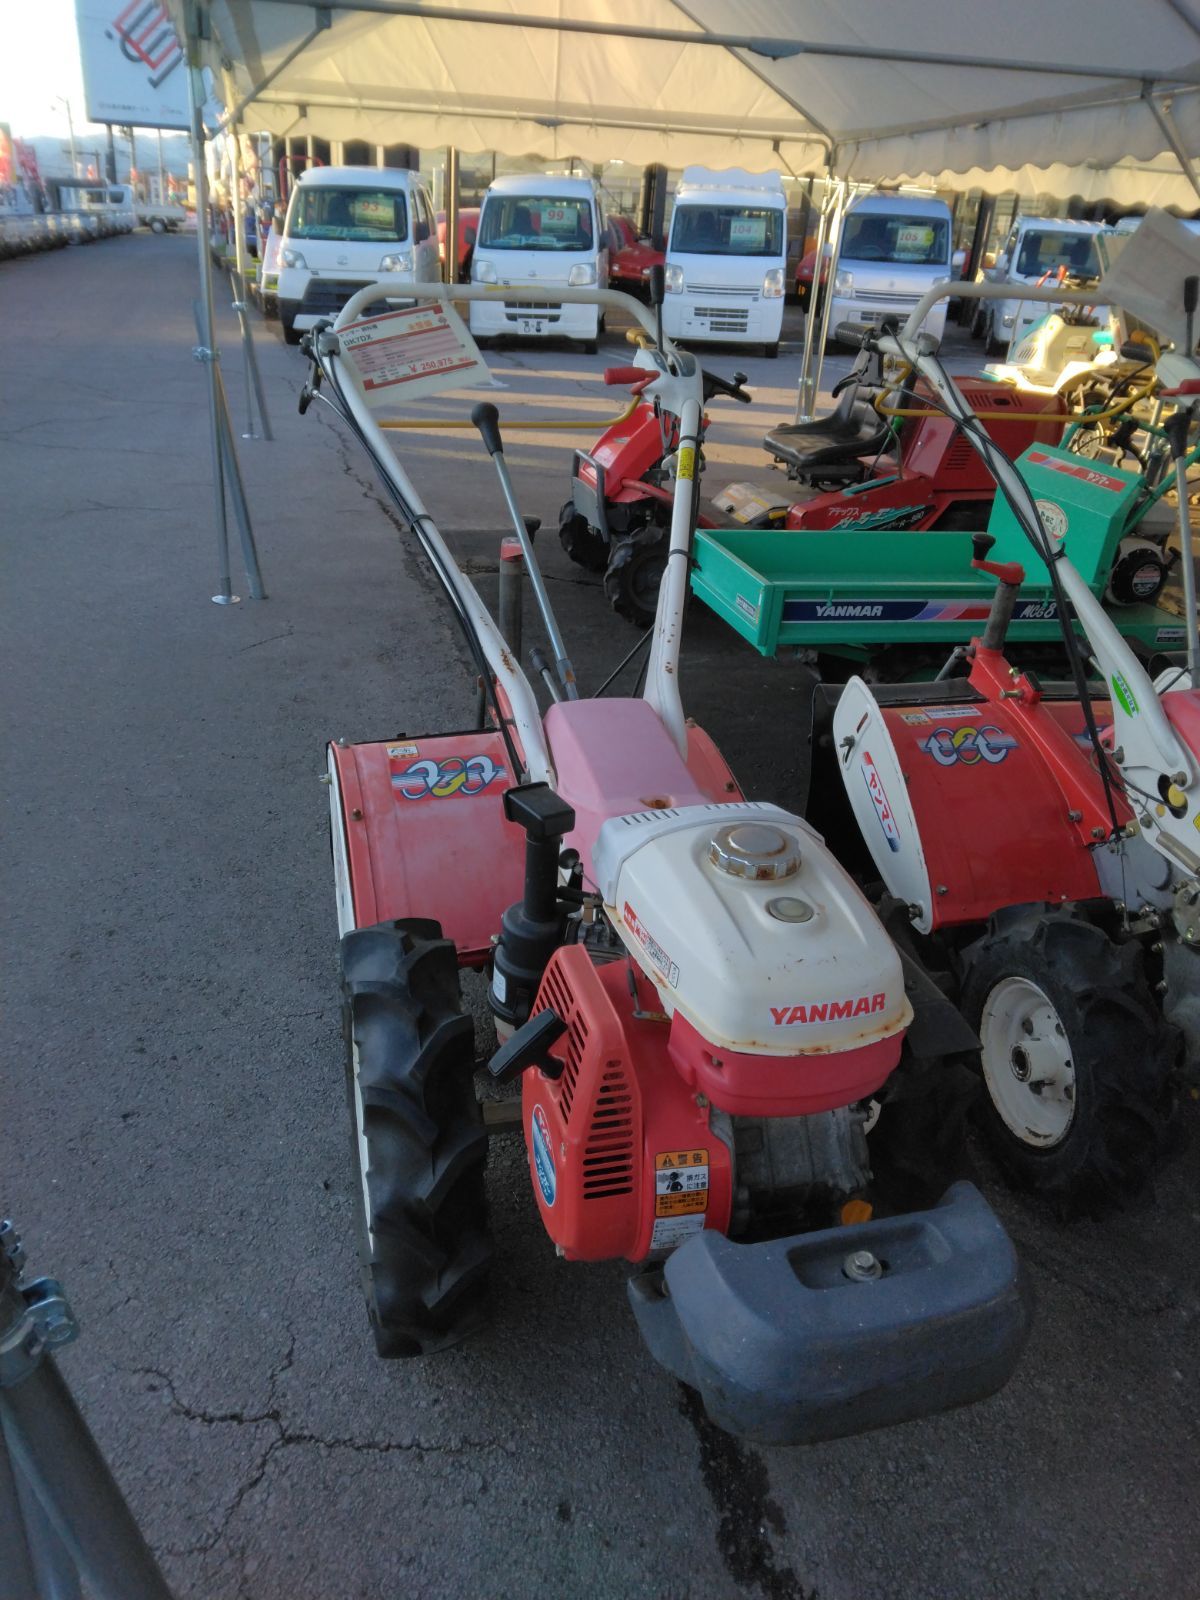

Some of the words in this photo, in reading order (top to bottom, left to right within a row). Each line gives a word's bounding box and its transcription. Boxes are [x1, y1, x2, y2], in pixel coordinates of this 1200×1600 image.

[547, 209, 565, 221] 99
[815, 605, 883, 617] YANMAR
[869, 772, 893, 833] ヤンマー
[769, 993, 886, 1026] YANMAR
